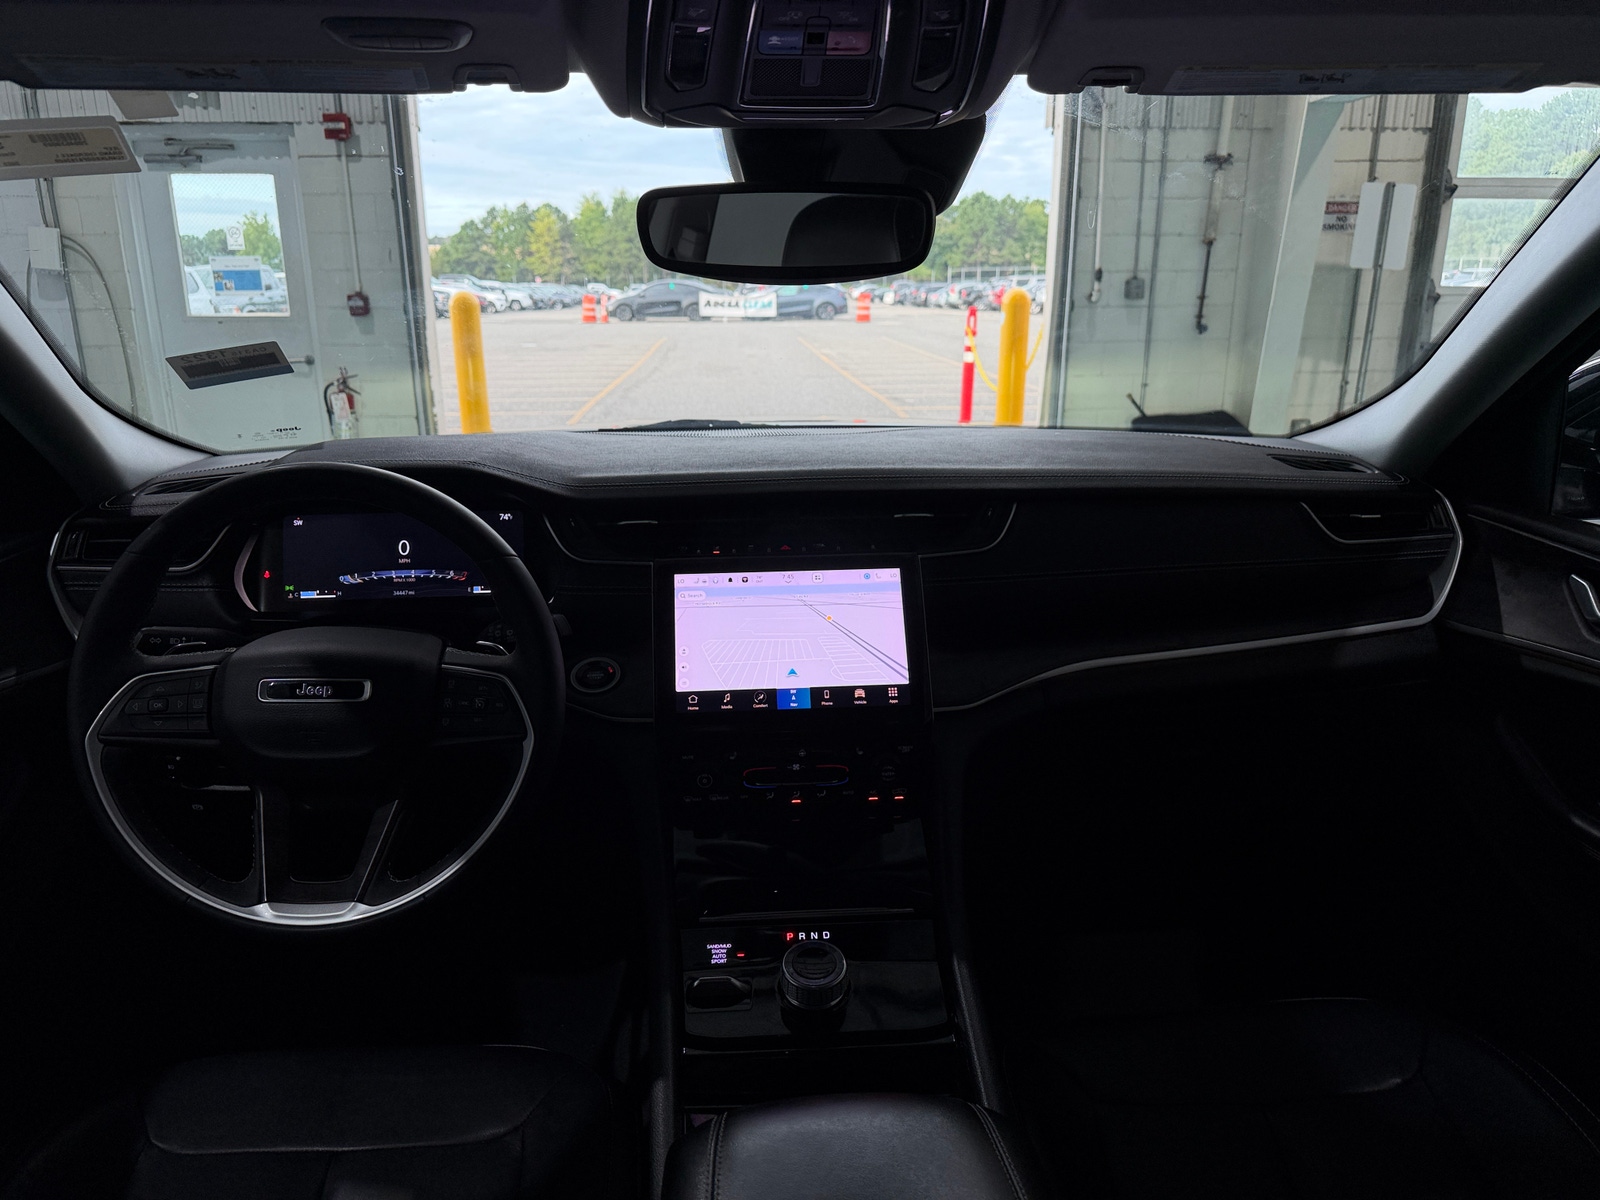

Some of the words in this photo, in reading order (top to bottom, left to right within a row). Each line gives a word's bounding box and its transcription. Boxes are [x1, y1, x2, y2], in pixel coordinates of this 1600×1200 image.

[1322, 223, 1356, 231] SMOKIN
[398, 540, 410, 556] 0
[296, 683, 333, 698] Jeep
